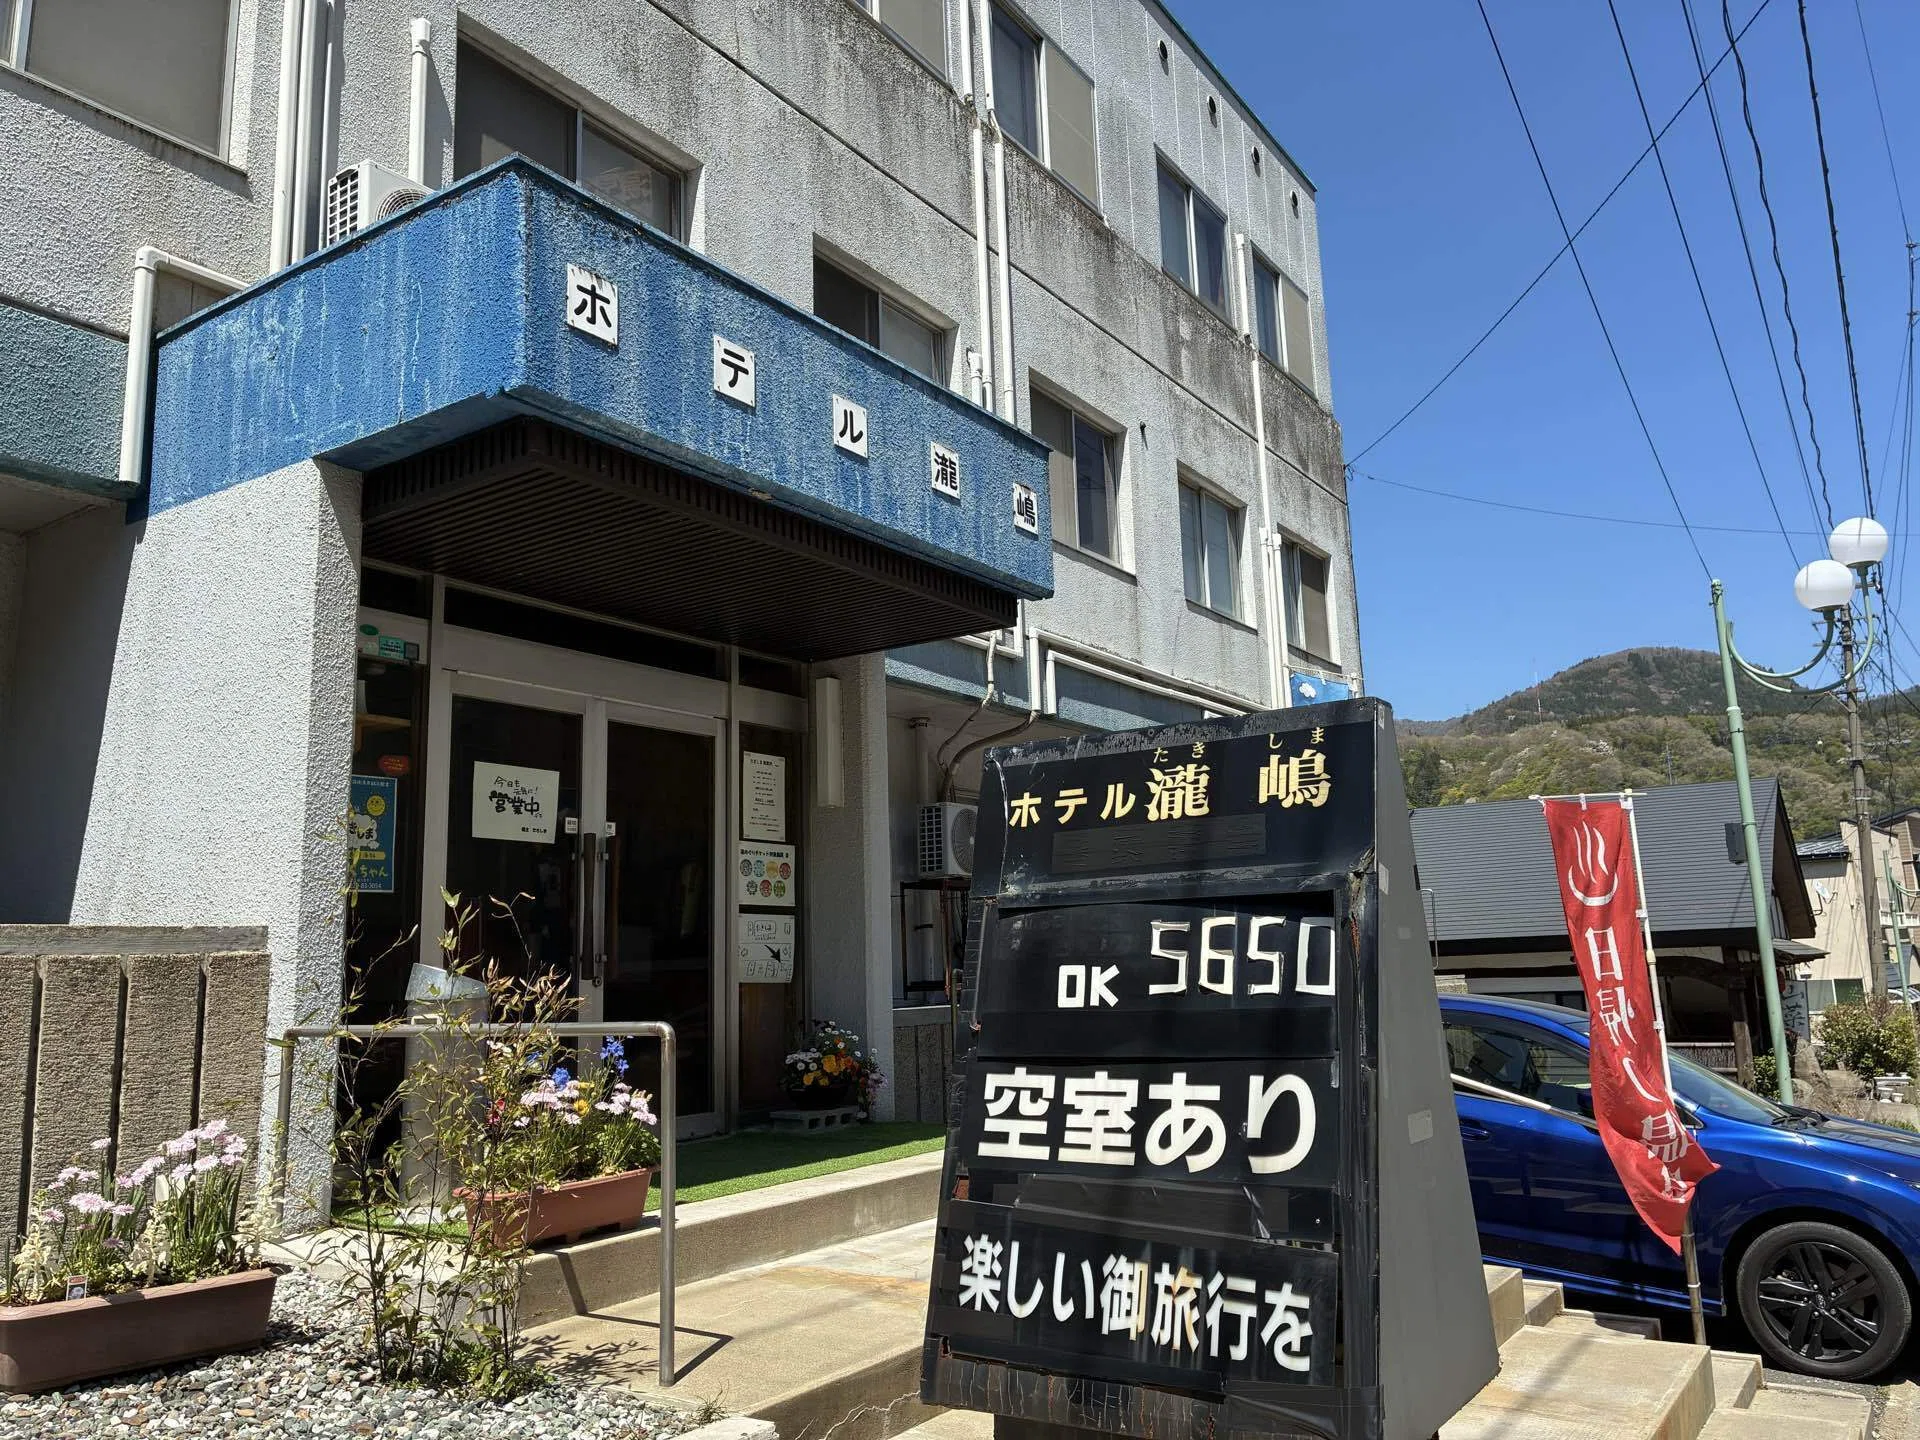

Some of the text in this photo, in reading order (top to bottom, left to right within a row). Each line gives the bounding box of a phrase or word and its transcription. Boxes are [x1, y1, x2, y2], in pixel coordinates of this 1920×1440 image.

[575, 283, 1036, 527] ホテル瀧嶋
[488, 790, 540, 815] 営業中
[494, 775, 520, 788] 今日も
[1057, 916, 1336, 1008] OK 5650
[977, 1066, 1316, 1174] 空室あり
[958, 1233, 1313, 1372] 楽しい御旅行を
